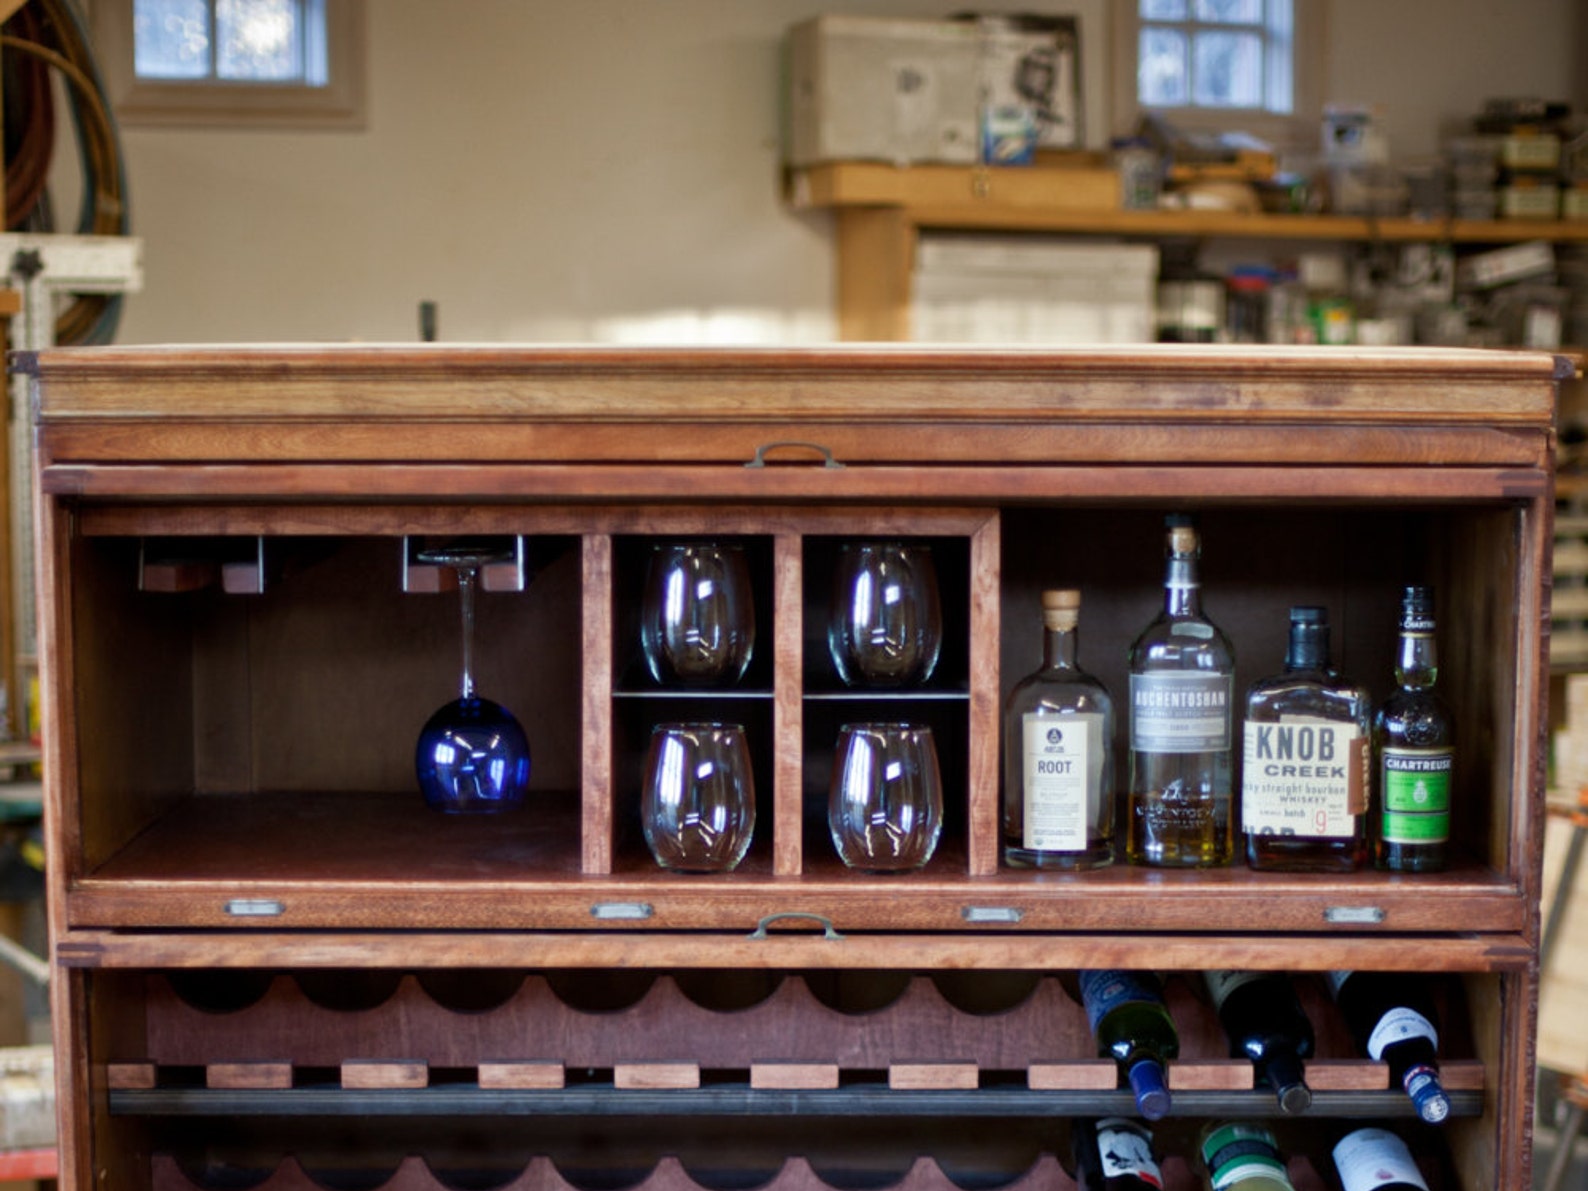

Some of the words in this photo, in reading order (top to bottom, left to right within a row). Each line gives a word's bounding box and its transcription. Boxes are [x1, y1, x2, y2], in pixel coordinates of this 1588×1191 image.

[1257, 726, 1334, 761] KNOB
[1038, 760, 1072, 774] ROOT
[1264, 765, 1345, 778] CREEK
[1262, 783, 1302, 796] straight
[1305, 783, 1346, 795] bourbon
[1315, 810, 1327, 834] 9
